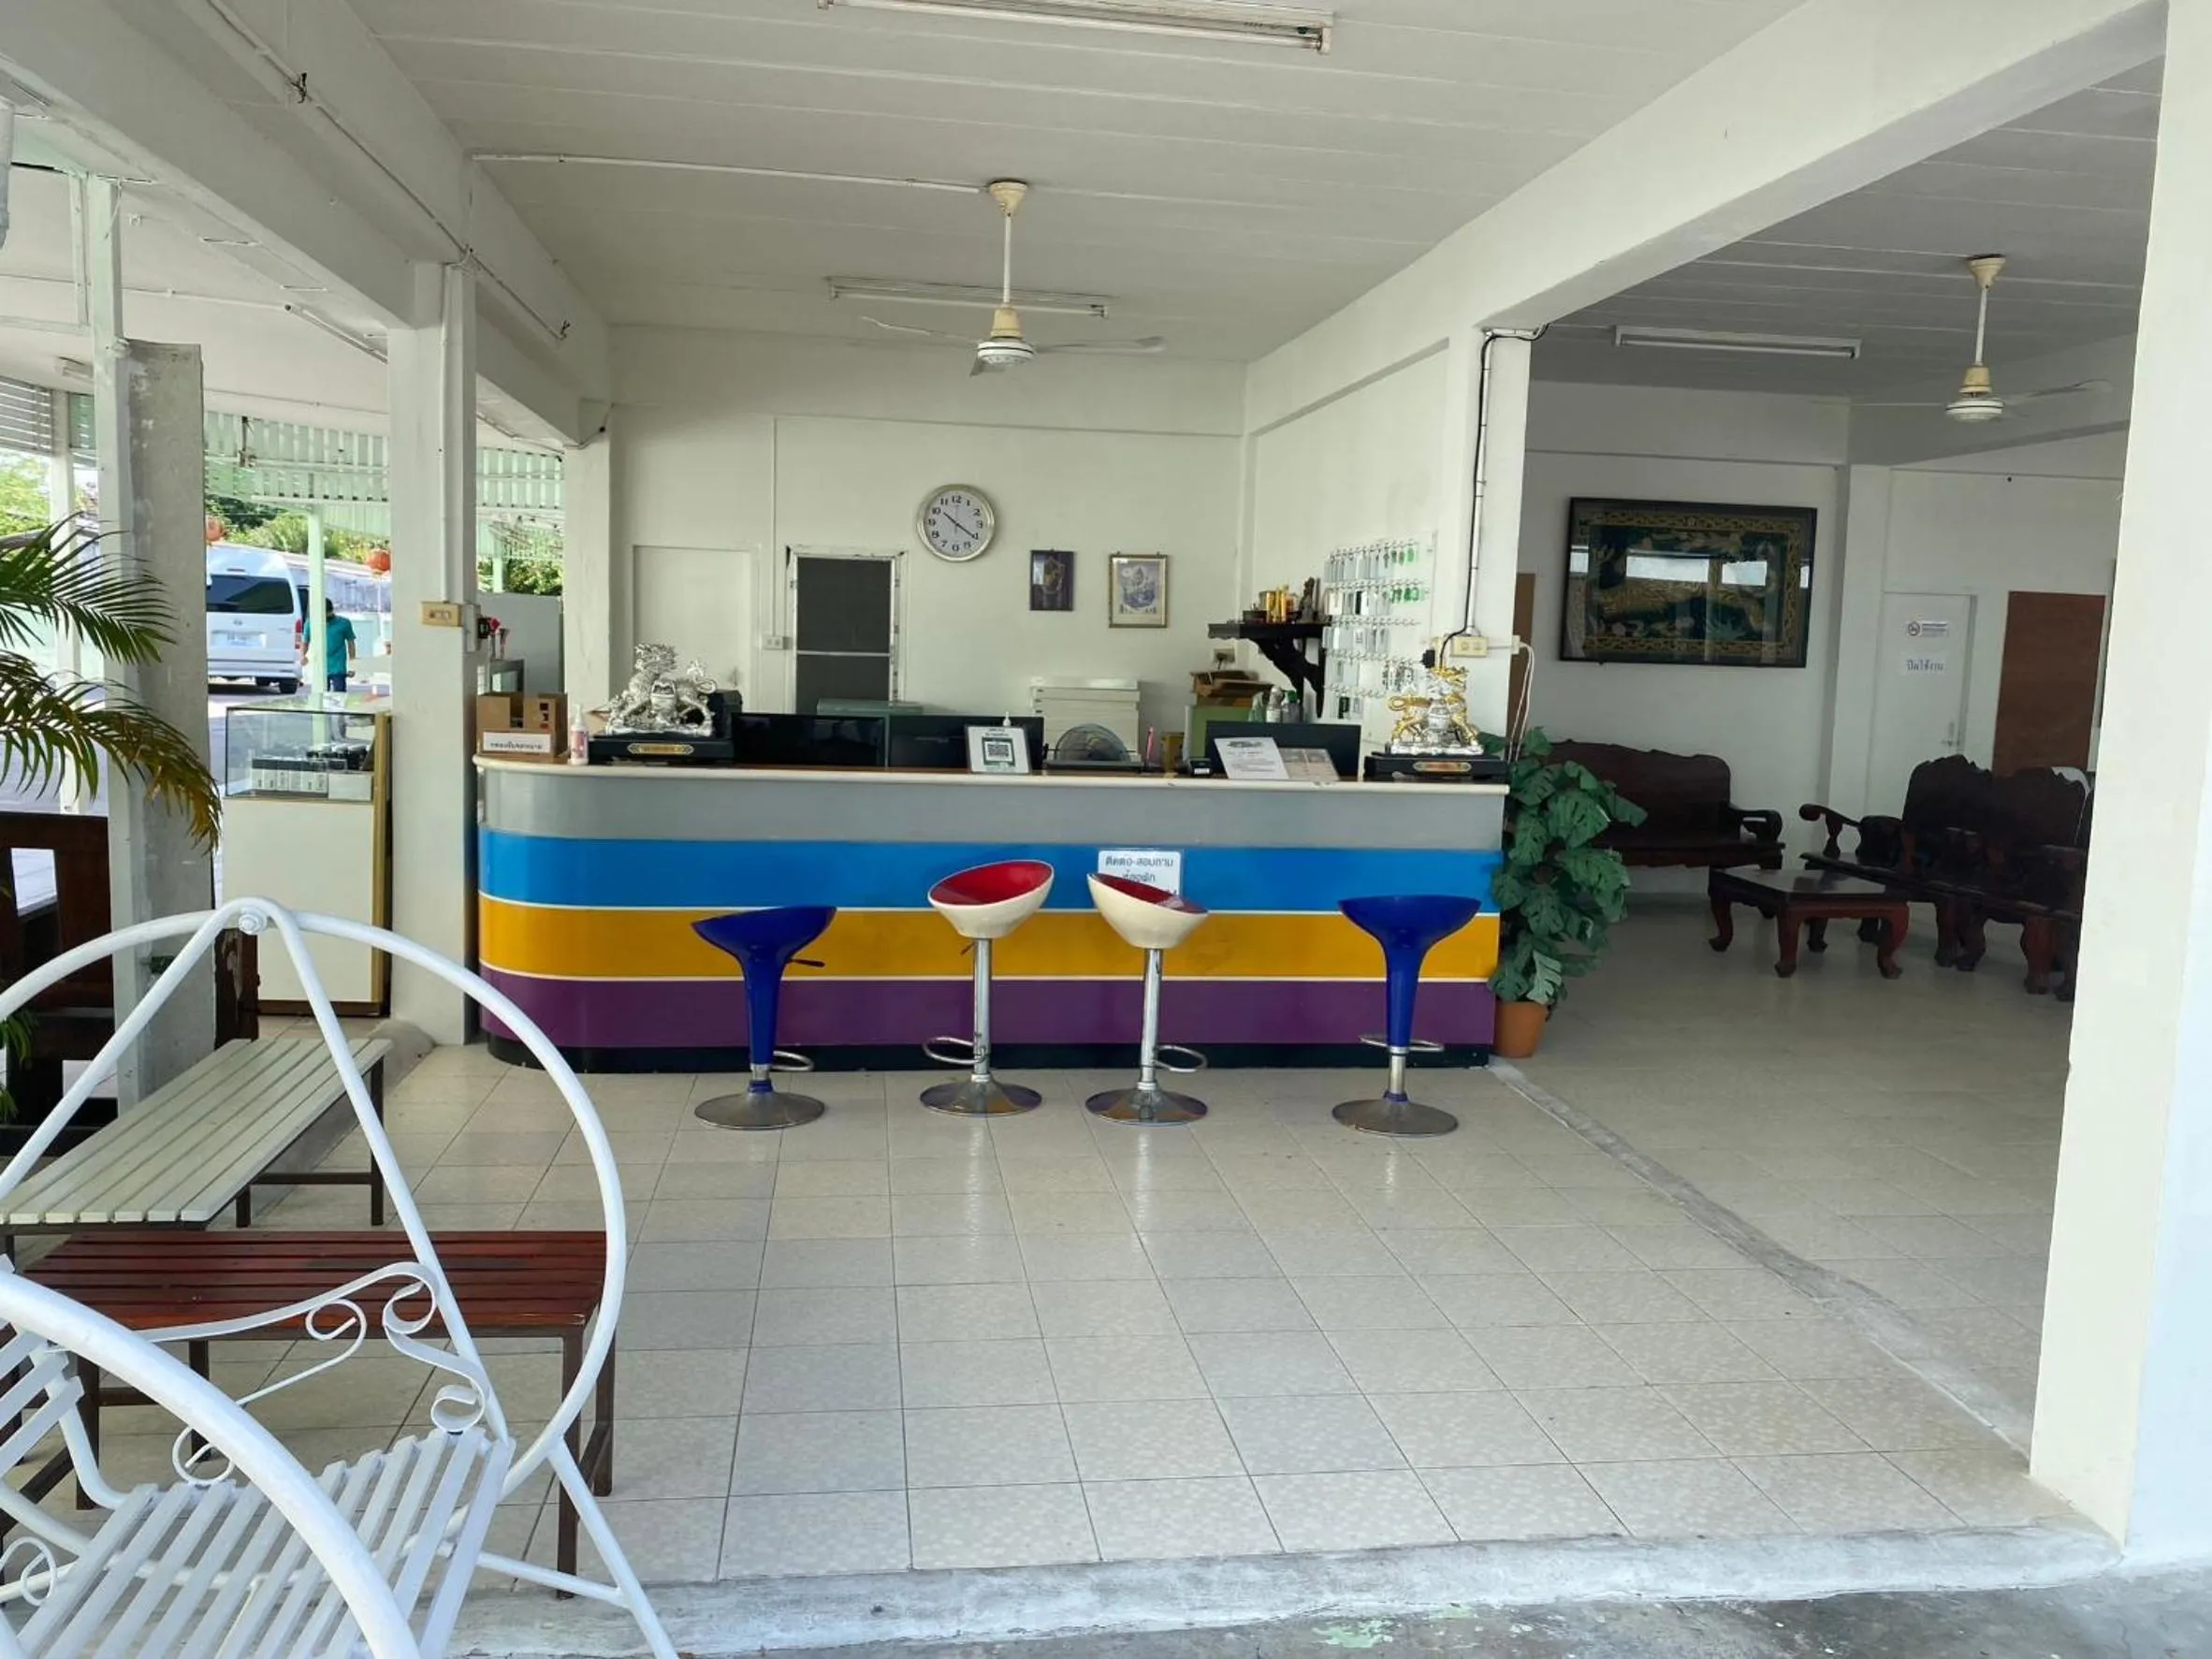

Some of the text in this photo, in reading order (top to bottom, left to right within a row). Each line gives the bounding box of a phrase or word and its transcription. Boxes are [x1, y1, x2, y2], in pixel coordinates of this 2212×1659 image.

[939, 498, 949, 506] 11
[951, 495, 962, 503] 12
[973, 508, 981, 517] 2
